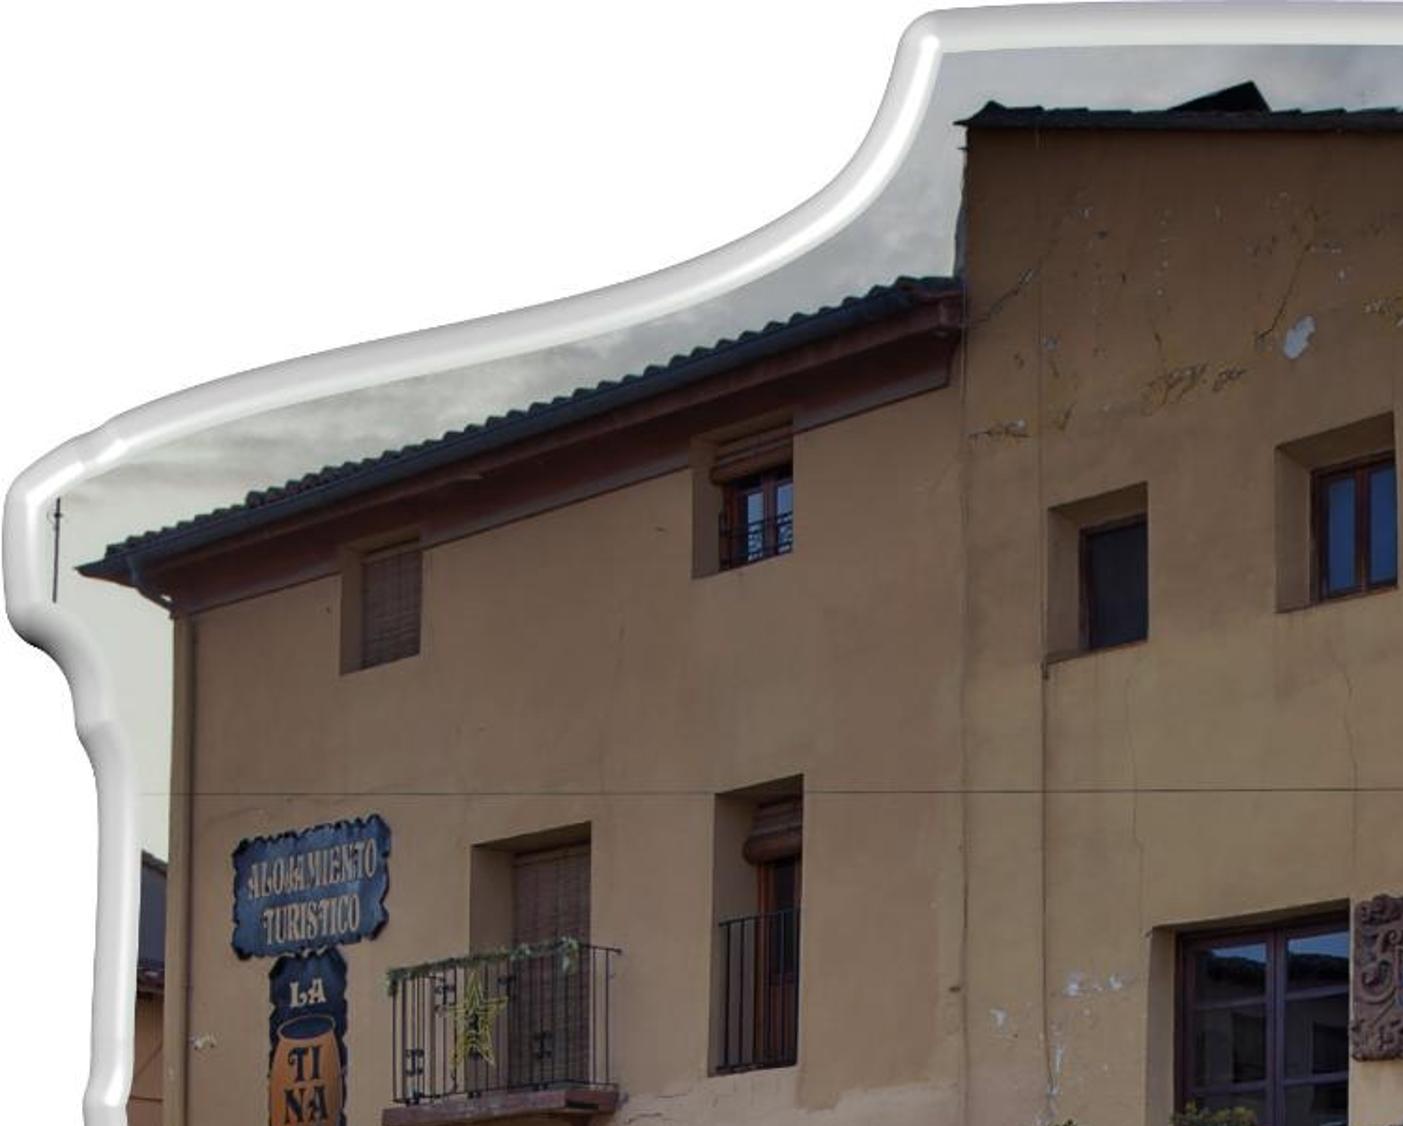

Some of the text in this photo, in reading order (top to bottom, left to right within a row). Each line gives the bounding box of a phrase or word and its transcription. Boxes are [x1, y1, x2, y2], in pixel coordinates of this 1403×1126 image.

[247, 839, 377, 899] ALOJAMIENTO
[263, 895, 361, 946] TURISTICO
[289, 978, 327, 1009] LA
